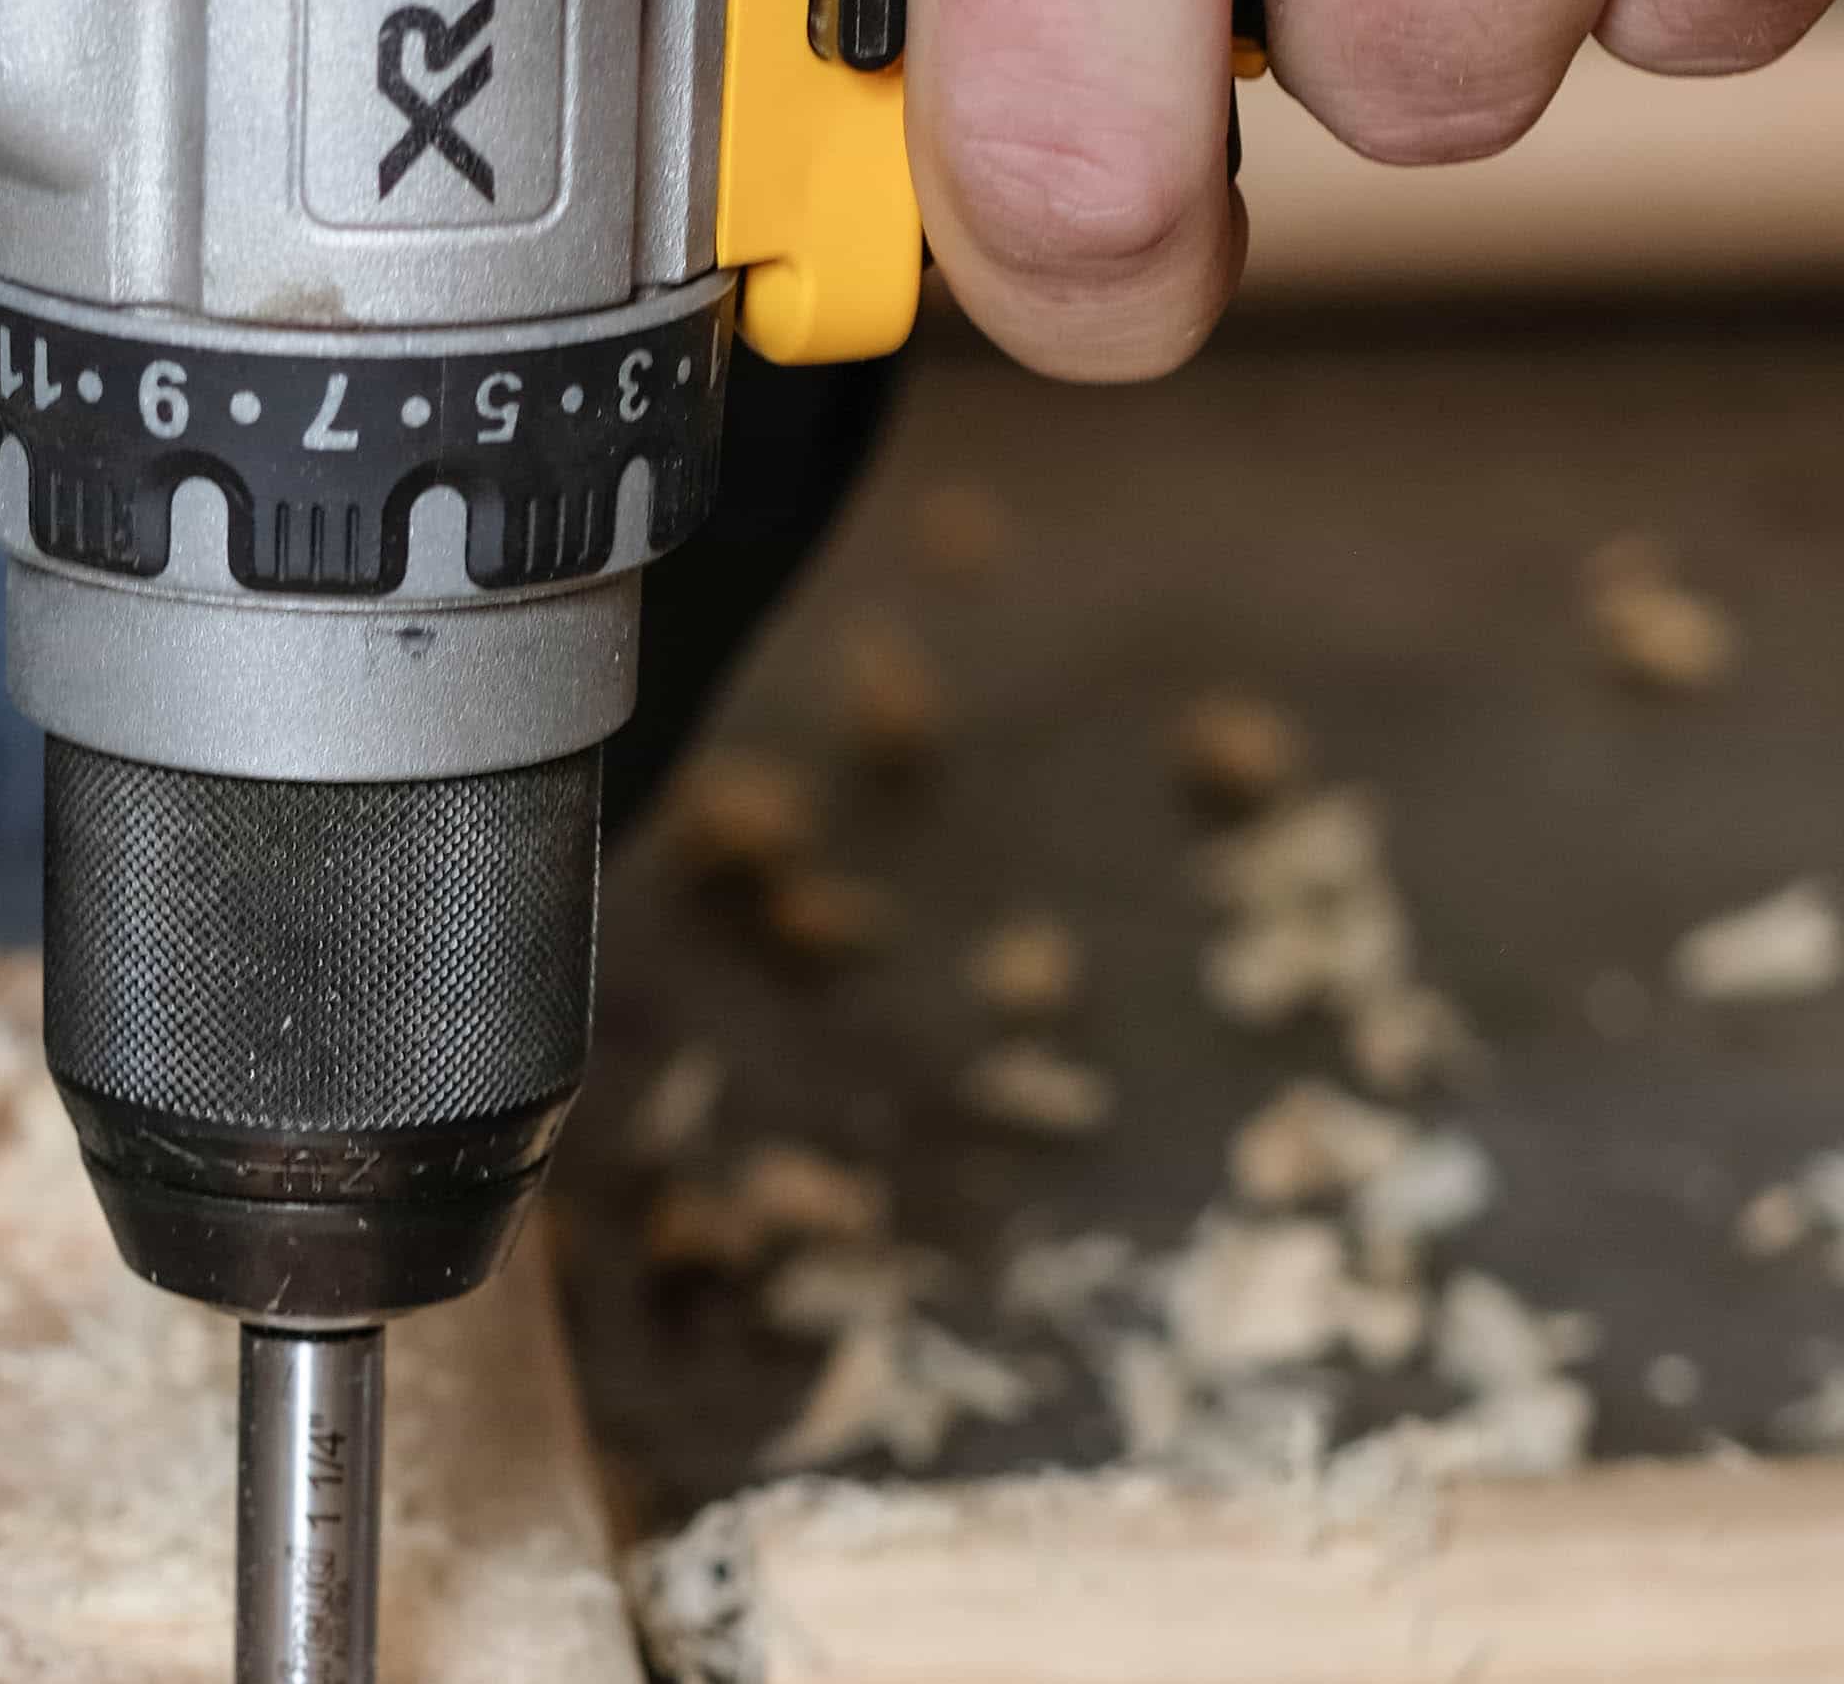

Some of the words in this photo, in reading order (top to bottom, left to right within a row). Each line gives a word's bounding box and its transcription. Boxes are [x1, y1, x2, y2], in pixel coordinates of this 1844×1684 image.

[0, 324, 62, 412] 11
[138, 359, 190, 440] 9
[618, 348, 654, 423] 3
[302, 372, 359, 450] 7
[475, 370, 523, 444] 5
[307, 1413, 349, 1490] 1/4"
[307, 1512, 341, 1529] 1
